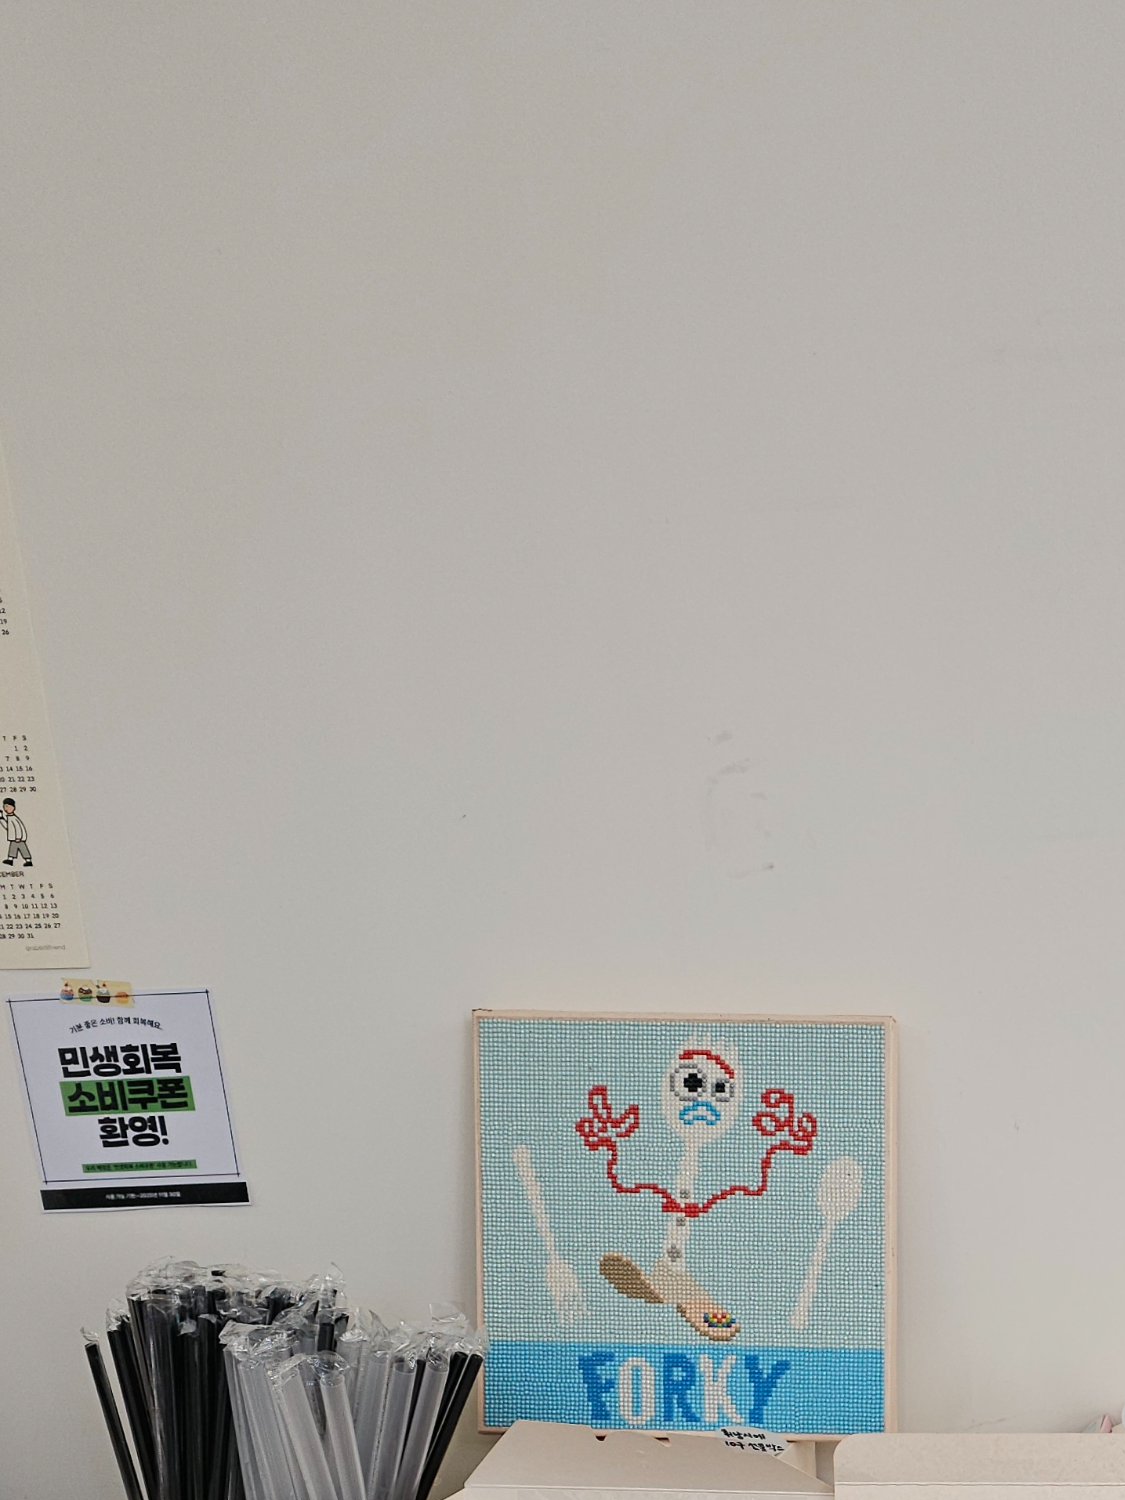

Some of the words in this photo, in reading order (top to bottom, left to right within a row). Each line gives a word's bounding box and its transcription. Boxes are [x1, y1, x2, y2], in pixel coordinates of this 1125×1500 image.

[84, 1019, 98, 1029] 좋은
[100, 1017, 115, 1025] 소비!
[117, 1016, 131, 1025] 함께
[58, 1043, 182, 1078] 민생회복
[67, 1078, 189, 1113] 소비쿠폰
[98, 1115, 169, 1148] 환영!
[577, 1351, 791, 1425] FORKY
[721, 1428, 766, 1440] 휘낭시에
[748, 1442, 784, 1452] 선물박스
